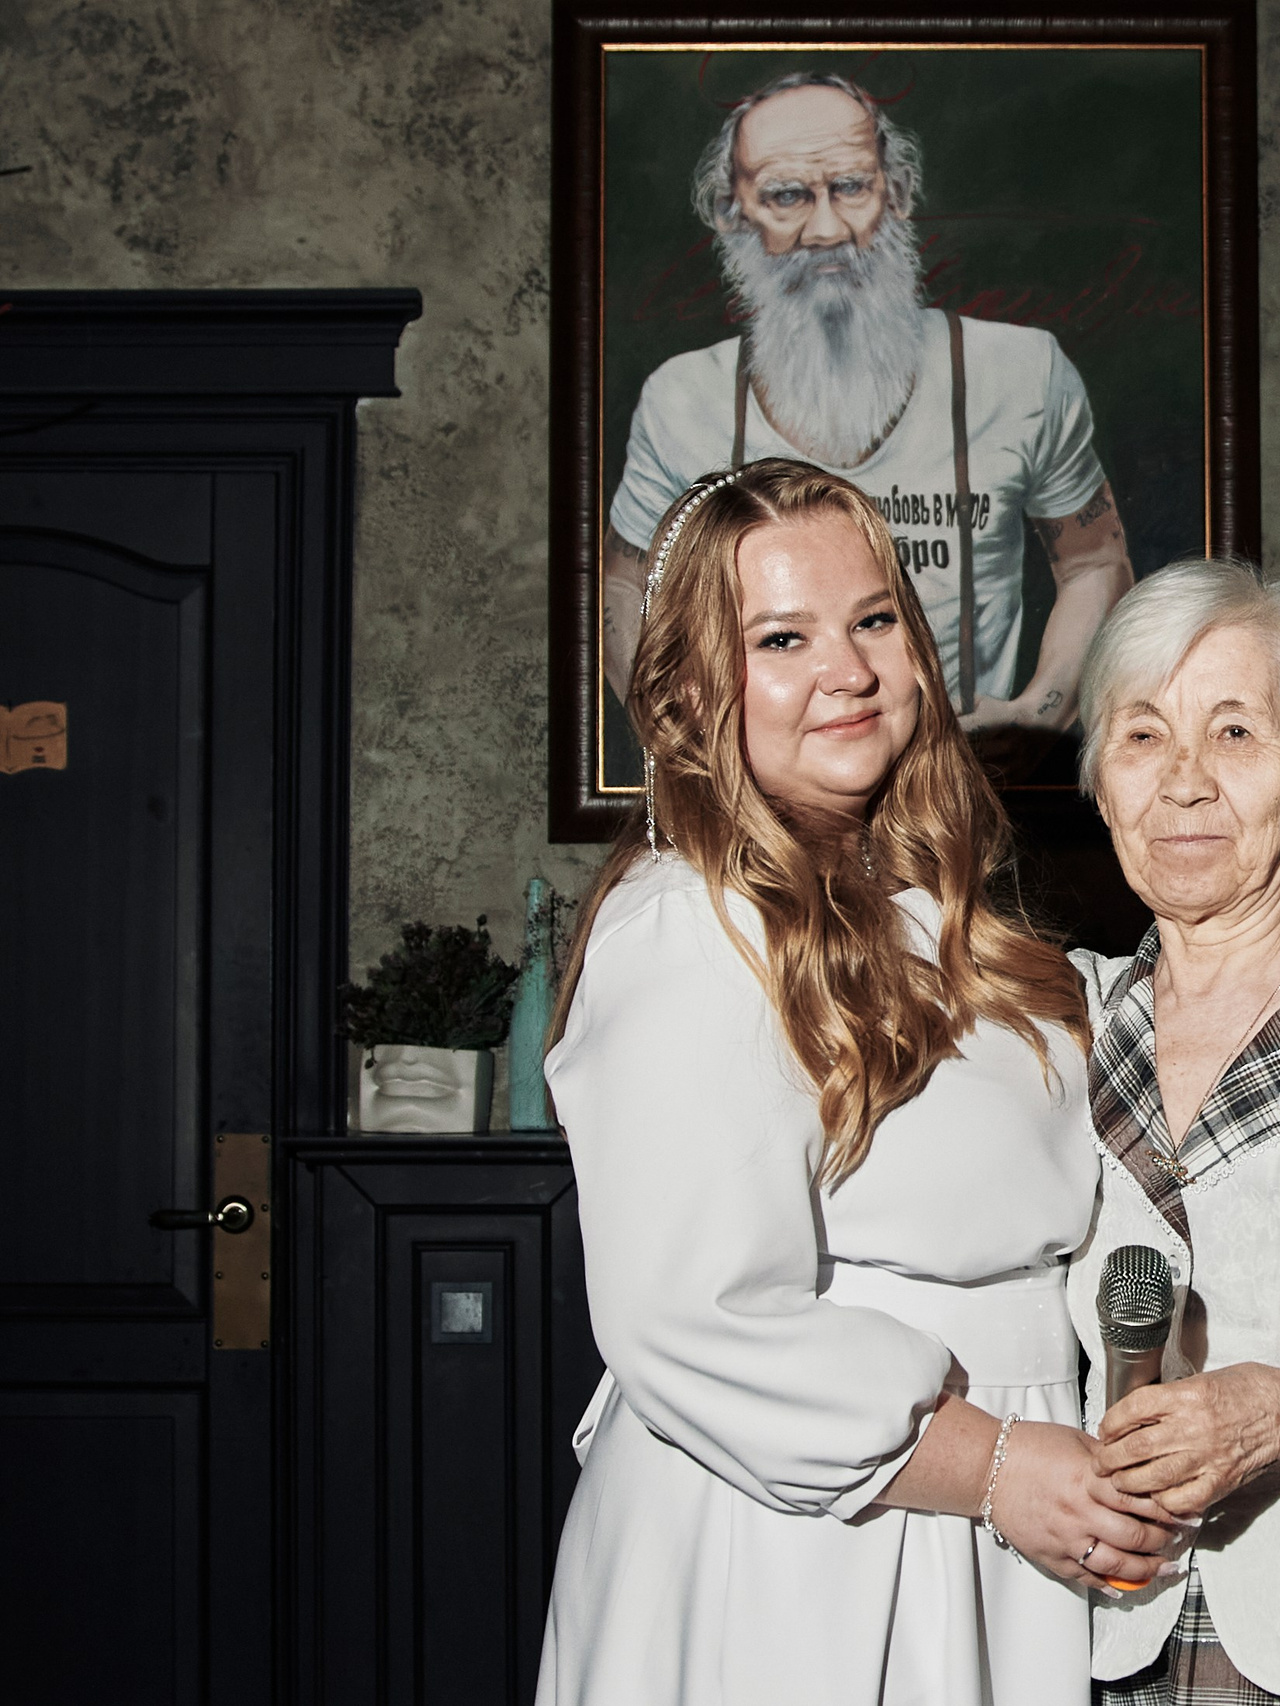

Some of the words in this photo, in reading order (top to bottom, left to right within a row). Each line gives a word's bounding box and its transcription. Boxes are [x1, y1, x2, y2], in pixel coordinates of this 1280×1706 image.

[875, 484, 929, 525] юбовь
[933, 493, 942, 526] в
[893, 536, 950, 574] бро
